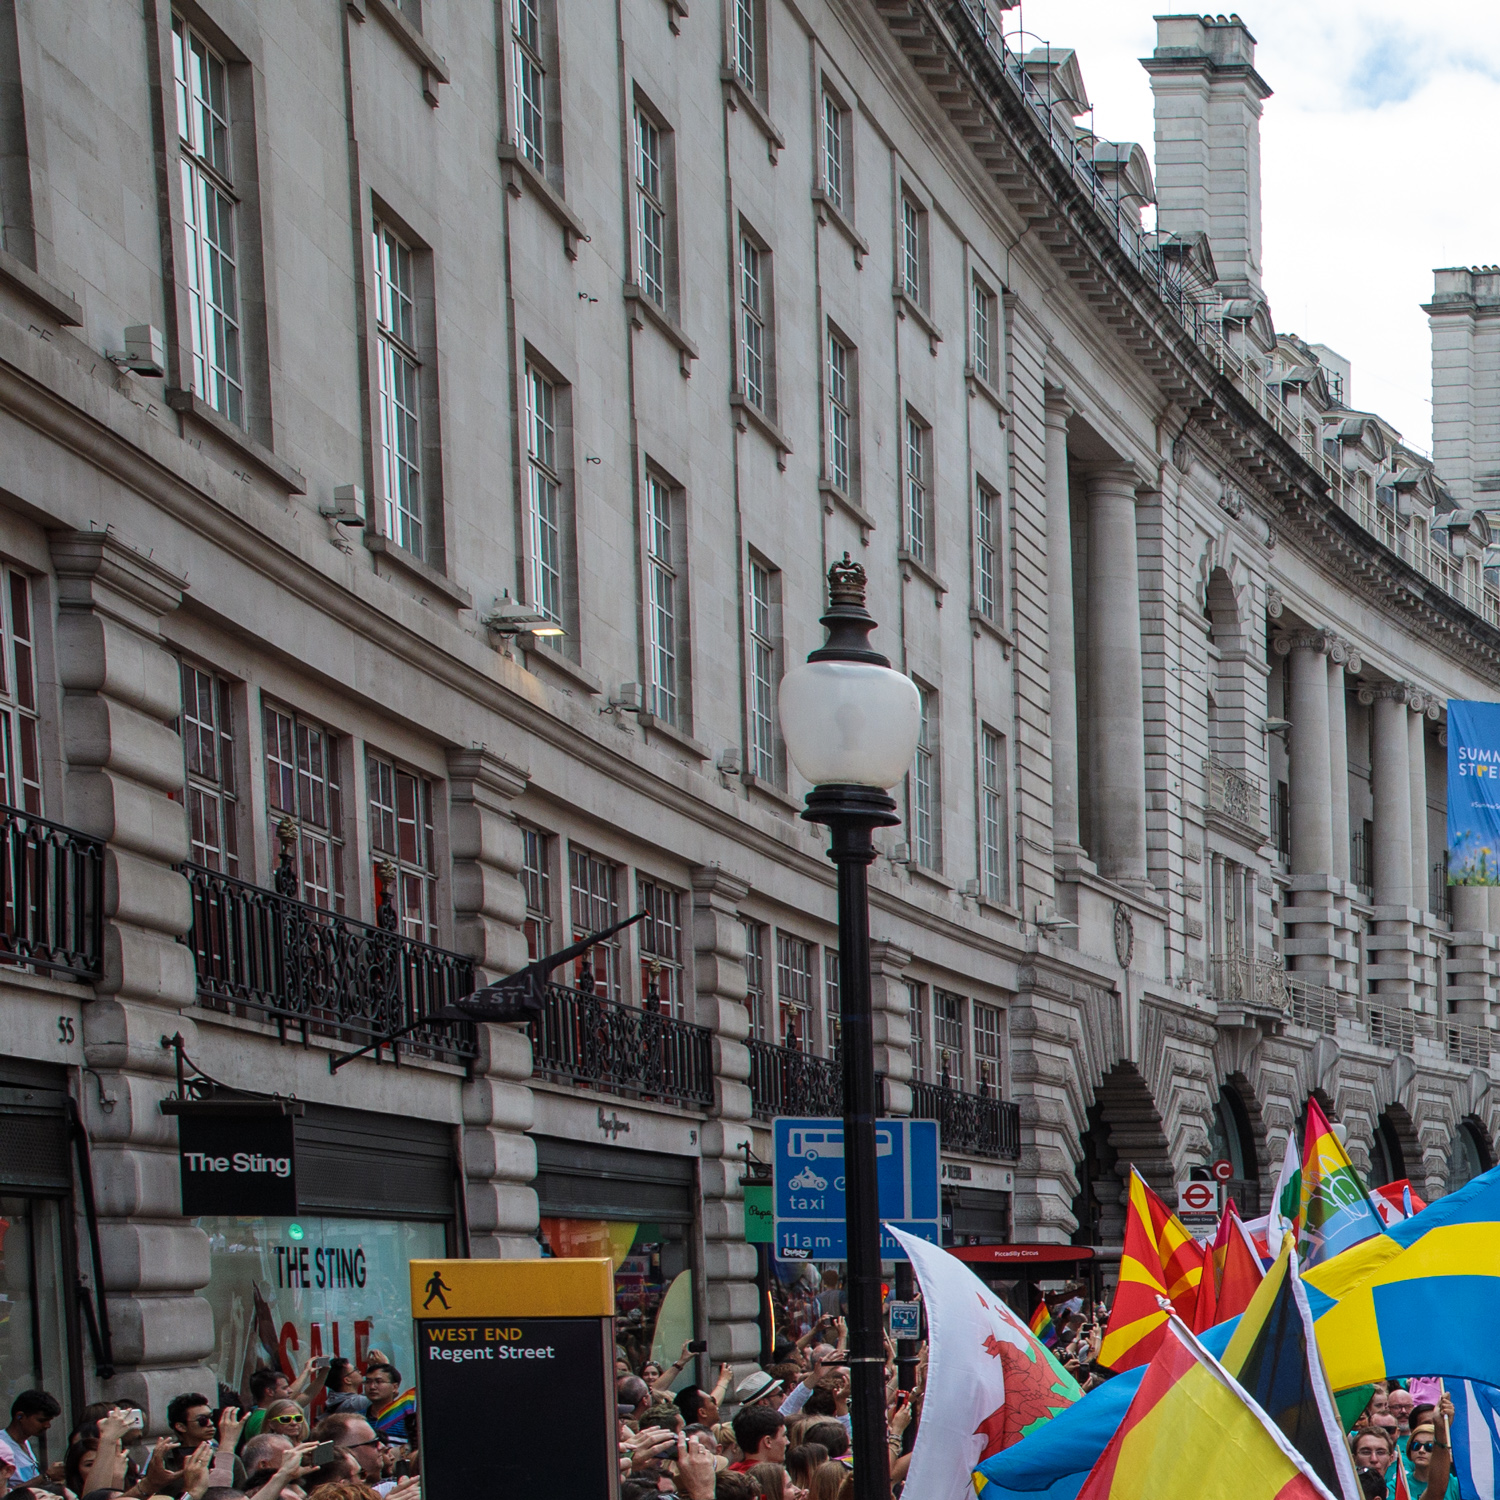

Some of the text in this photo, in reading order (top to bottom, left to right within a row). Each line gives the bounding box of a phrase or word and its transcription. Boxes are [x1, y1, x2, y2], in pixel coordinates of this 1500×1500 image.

[58, 1016, 75, 1044] 55
[184, 1153, 292, 1178] The Sting
[1215, 1163, 1230, 1179] C
[789, 1194, 825, 1210] taxi
[994, 1250, 1021, 1258] Piccadilly
[273, 1246, 367, 1288] THE STING
[893, 1310, 917, 1320] CCTV
[427, 1328, 523, 1341] WEST END
[429, 1345, 556, 1363] Regent Street
